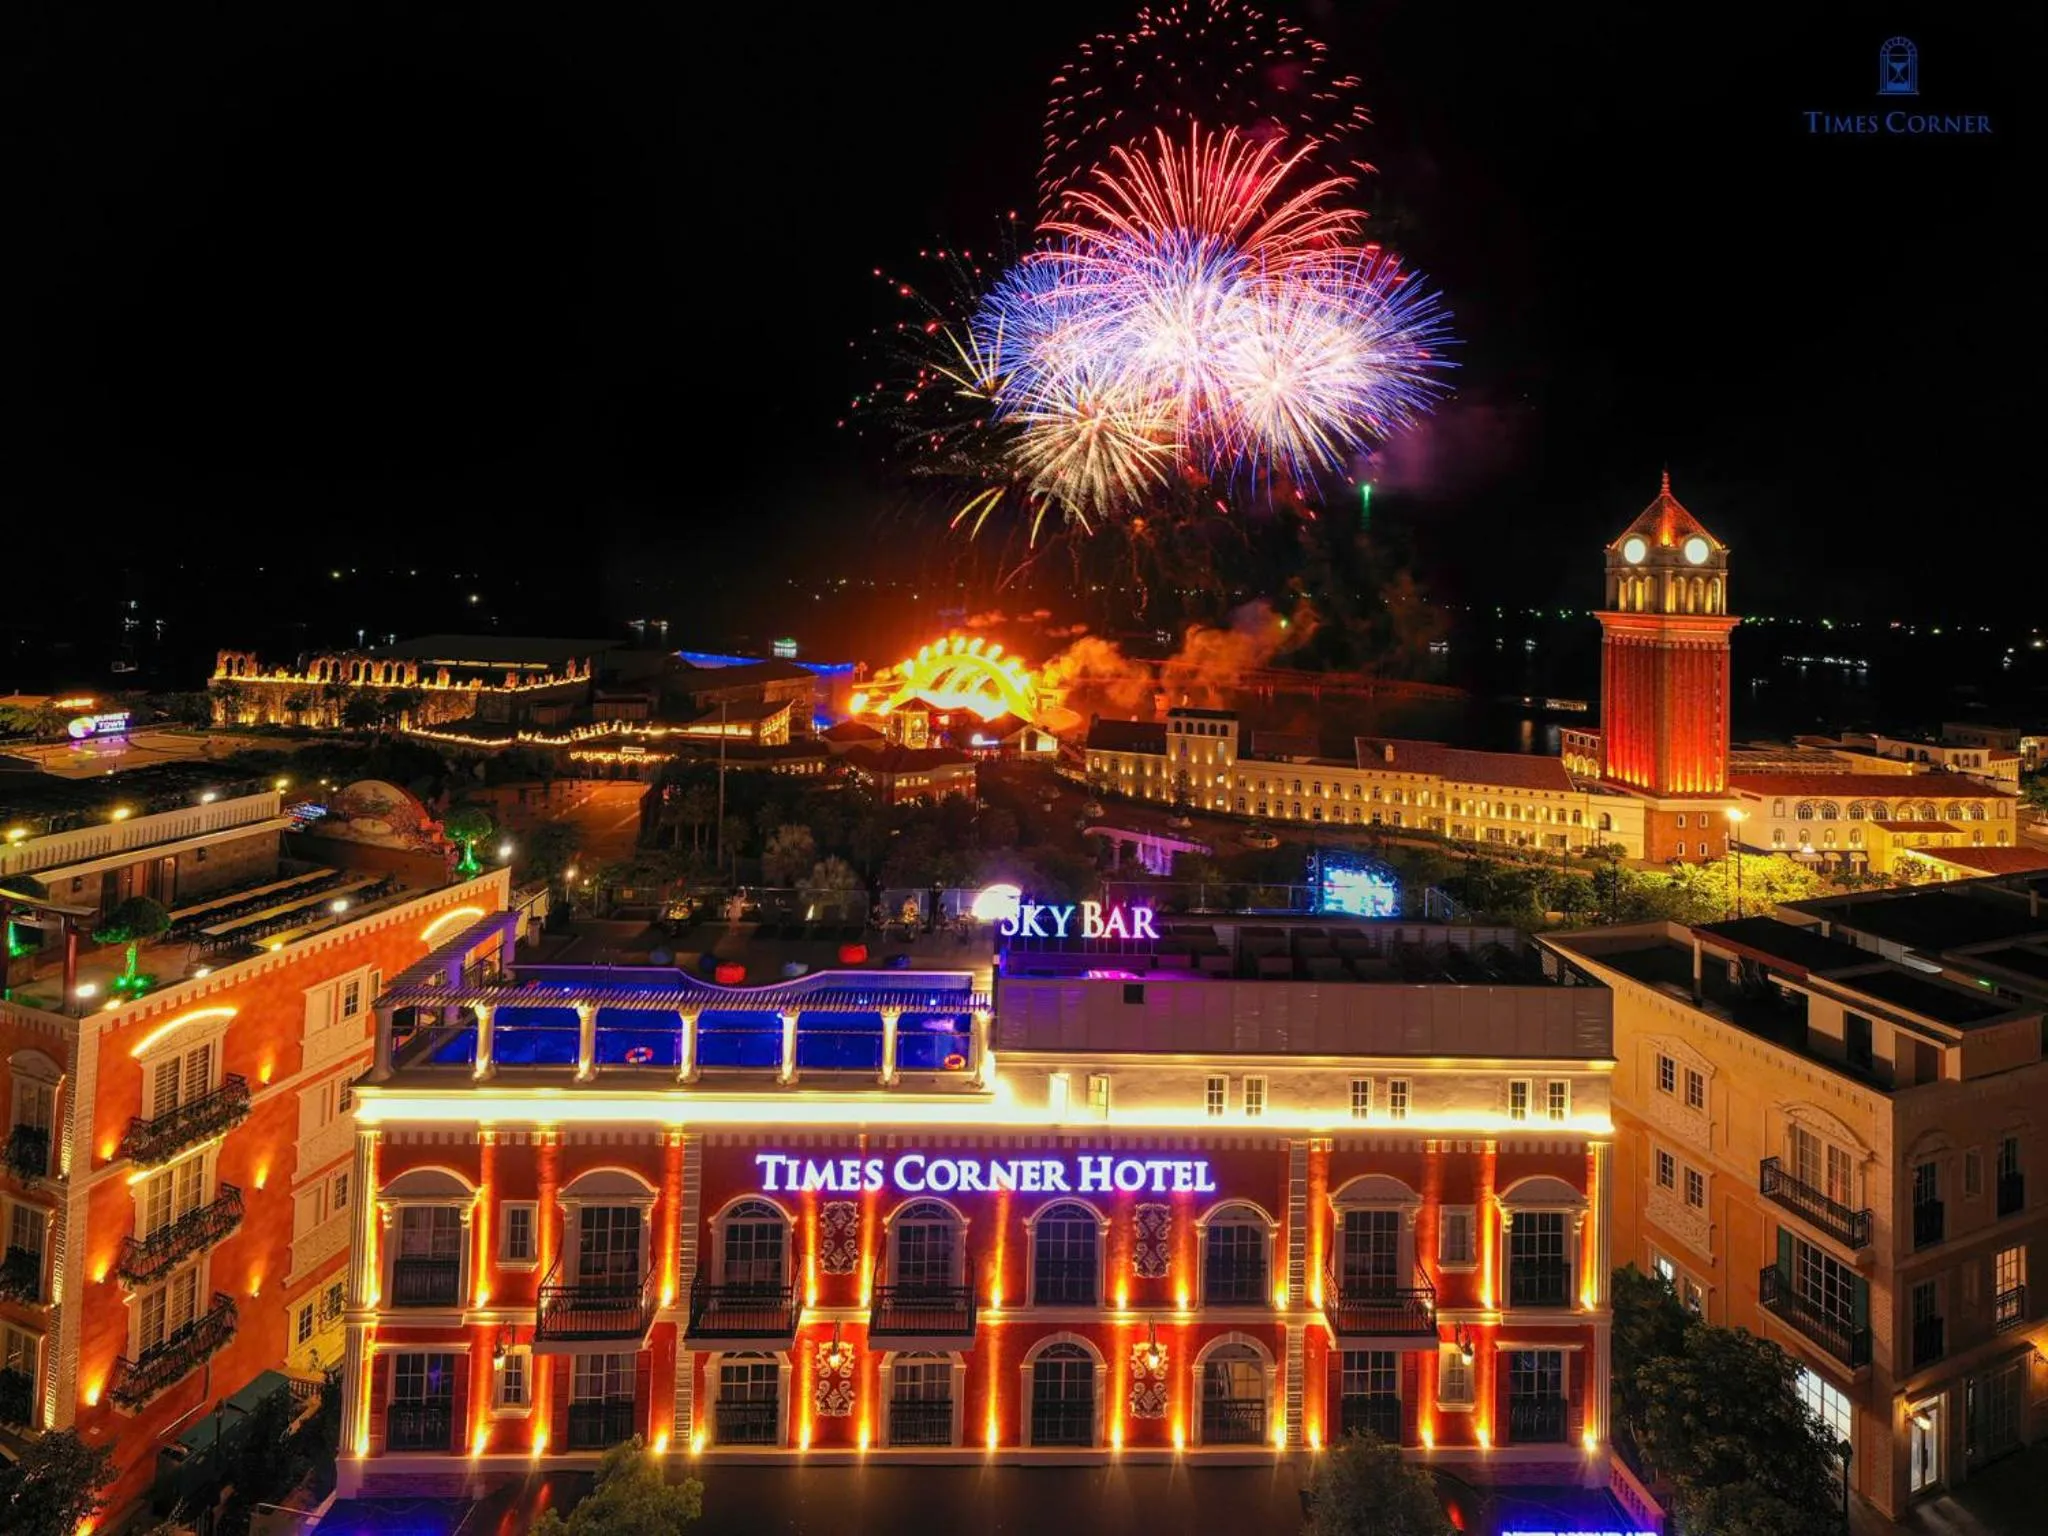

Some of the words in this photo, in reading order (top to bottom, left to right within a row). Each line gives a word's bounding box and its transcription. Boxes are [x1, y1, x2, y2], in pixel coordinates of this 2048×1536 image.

[1001, 899, 1076, 938] SKY
[1080, 900, 1161, 939] BAR
[755, 1154, 885, 1192] TIMES
[893, 1154, 1071, 1192] CORNER
[1077, 1156, 1217, 1192] HOTEL
